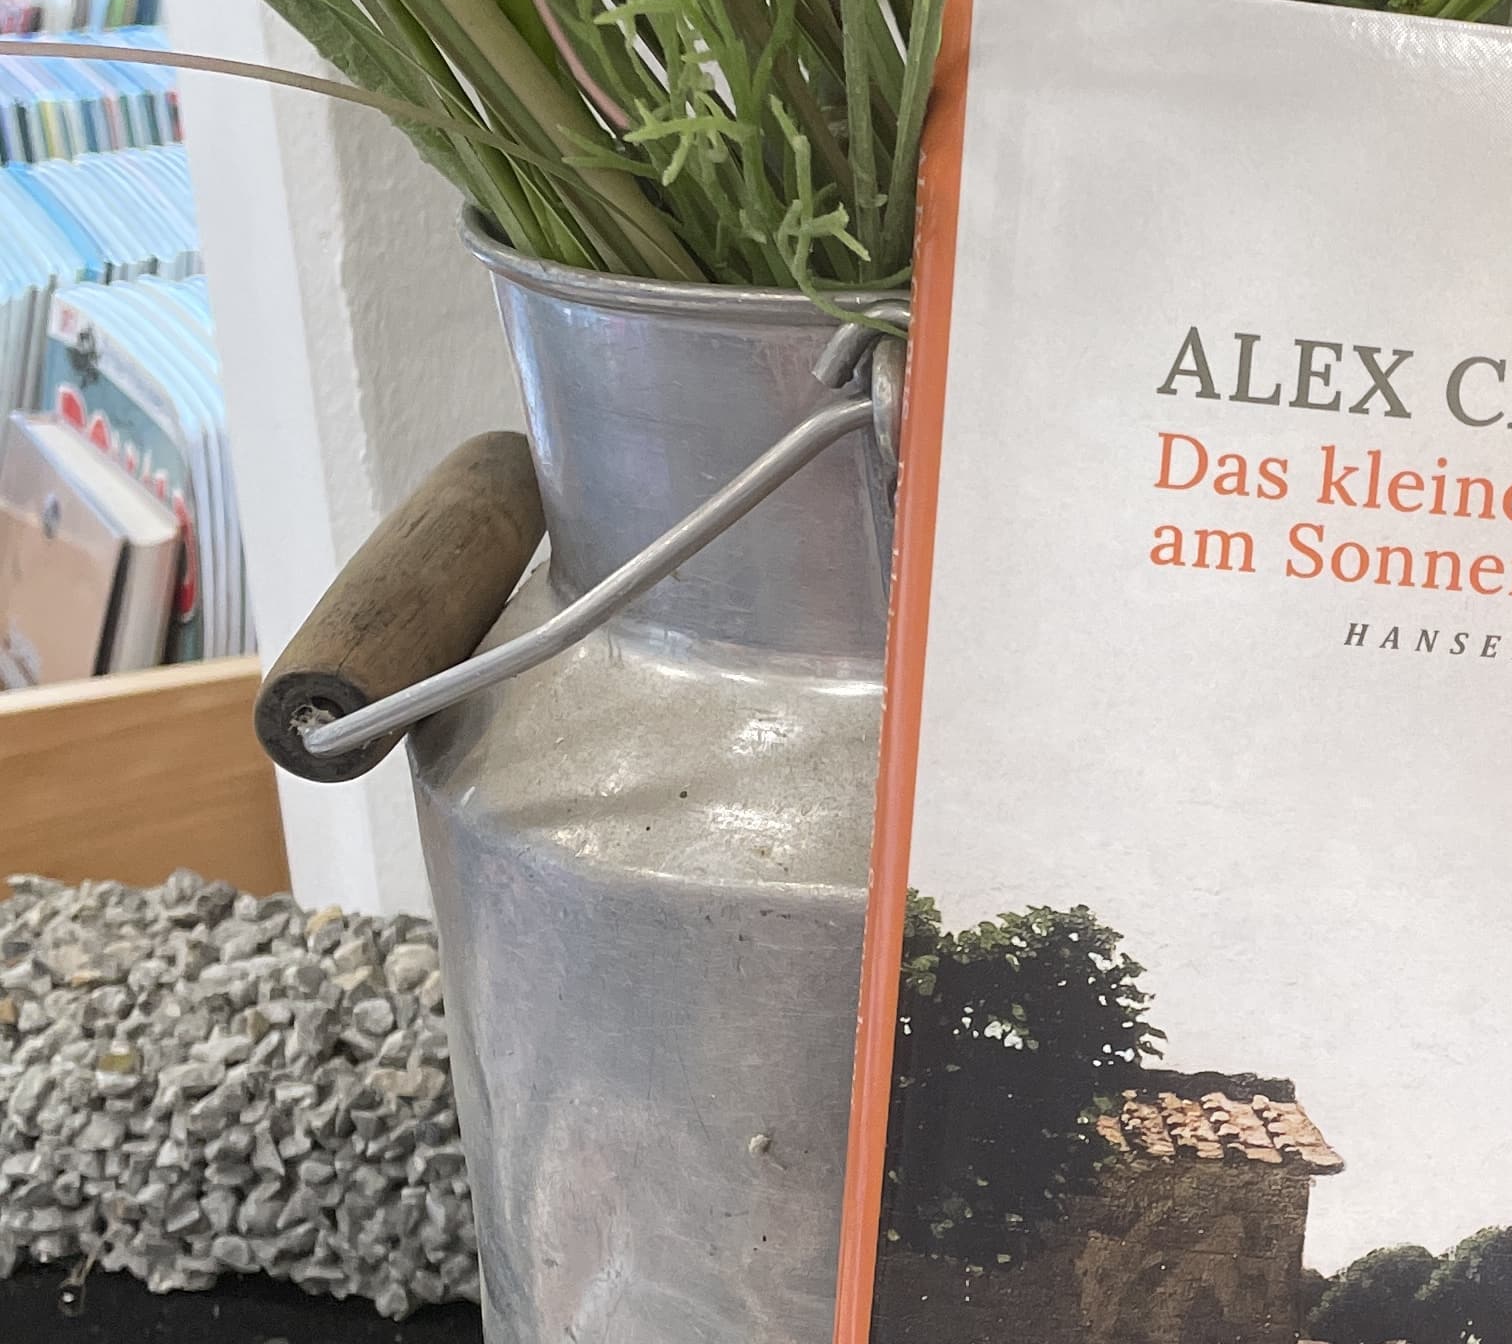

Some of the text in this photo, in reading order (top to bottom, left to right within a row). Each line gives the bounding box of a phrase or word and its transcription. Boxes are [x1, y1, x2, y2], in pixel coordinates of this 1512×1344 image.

[1156, 326, 1414, 419] ALEX
[1155, 432, 1289, 501] Das
[1150, 524, 1254, 574] am
